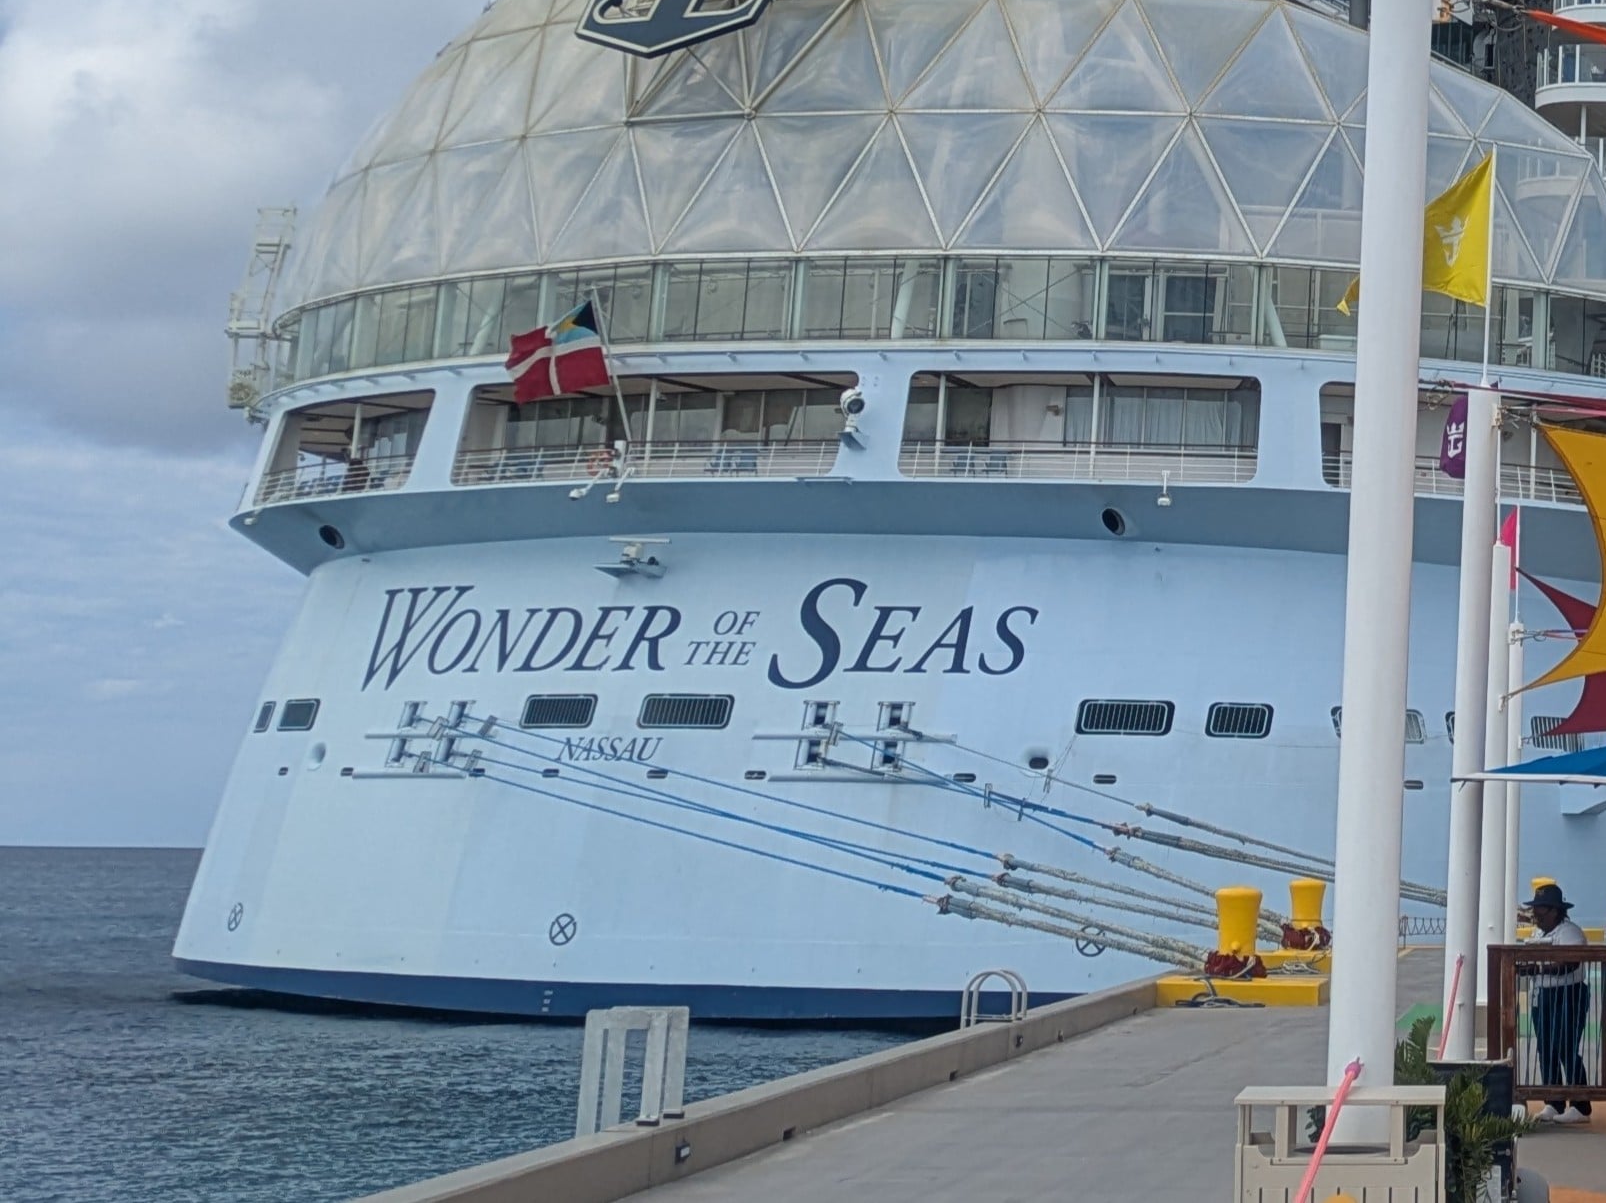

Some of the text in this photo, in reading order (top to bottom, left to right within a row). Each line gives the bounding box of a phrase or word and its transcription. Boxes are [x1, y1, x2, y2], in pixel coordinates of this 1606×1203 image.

[361, 578, 1039, 691] WONDER OF THE SEAS
[554, 736, 663, 761] NASSAU
